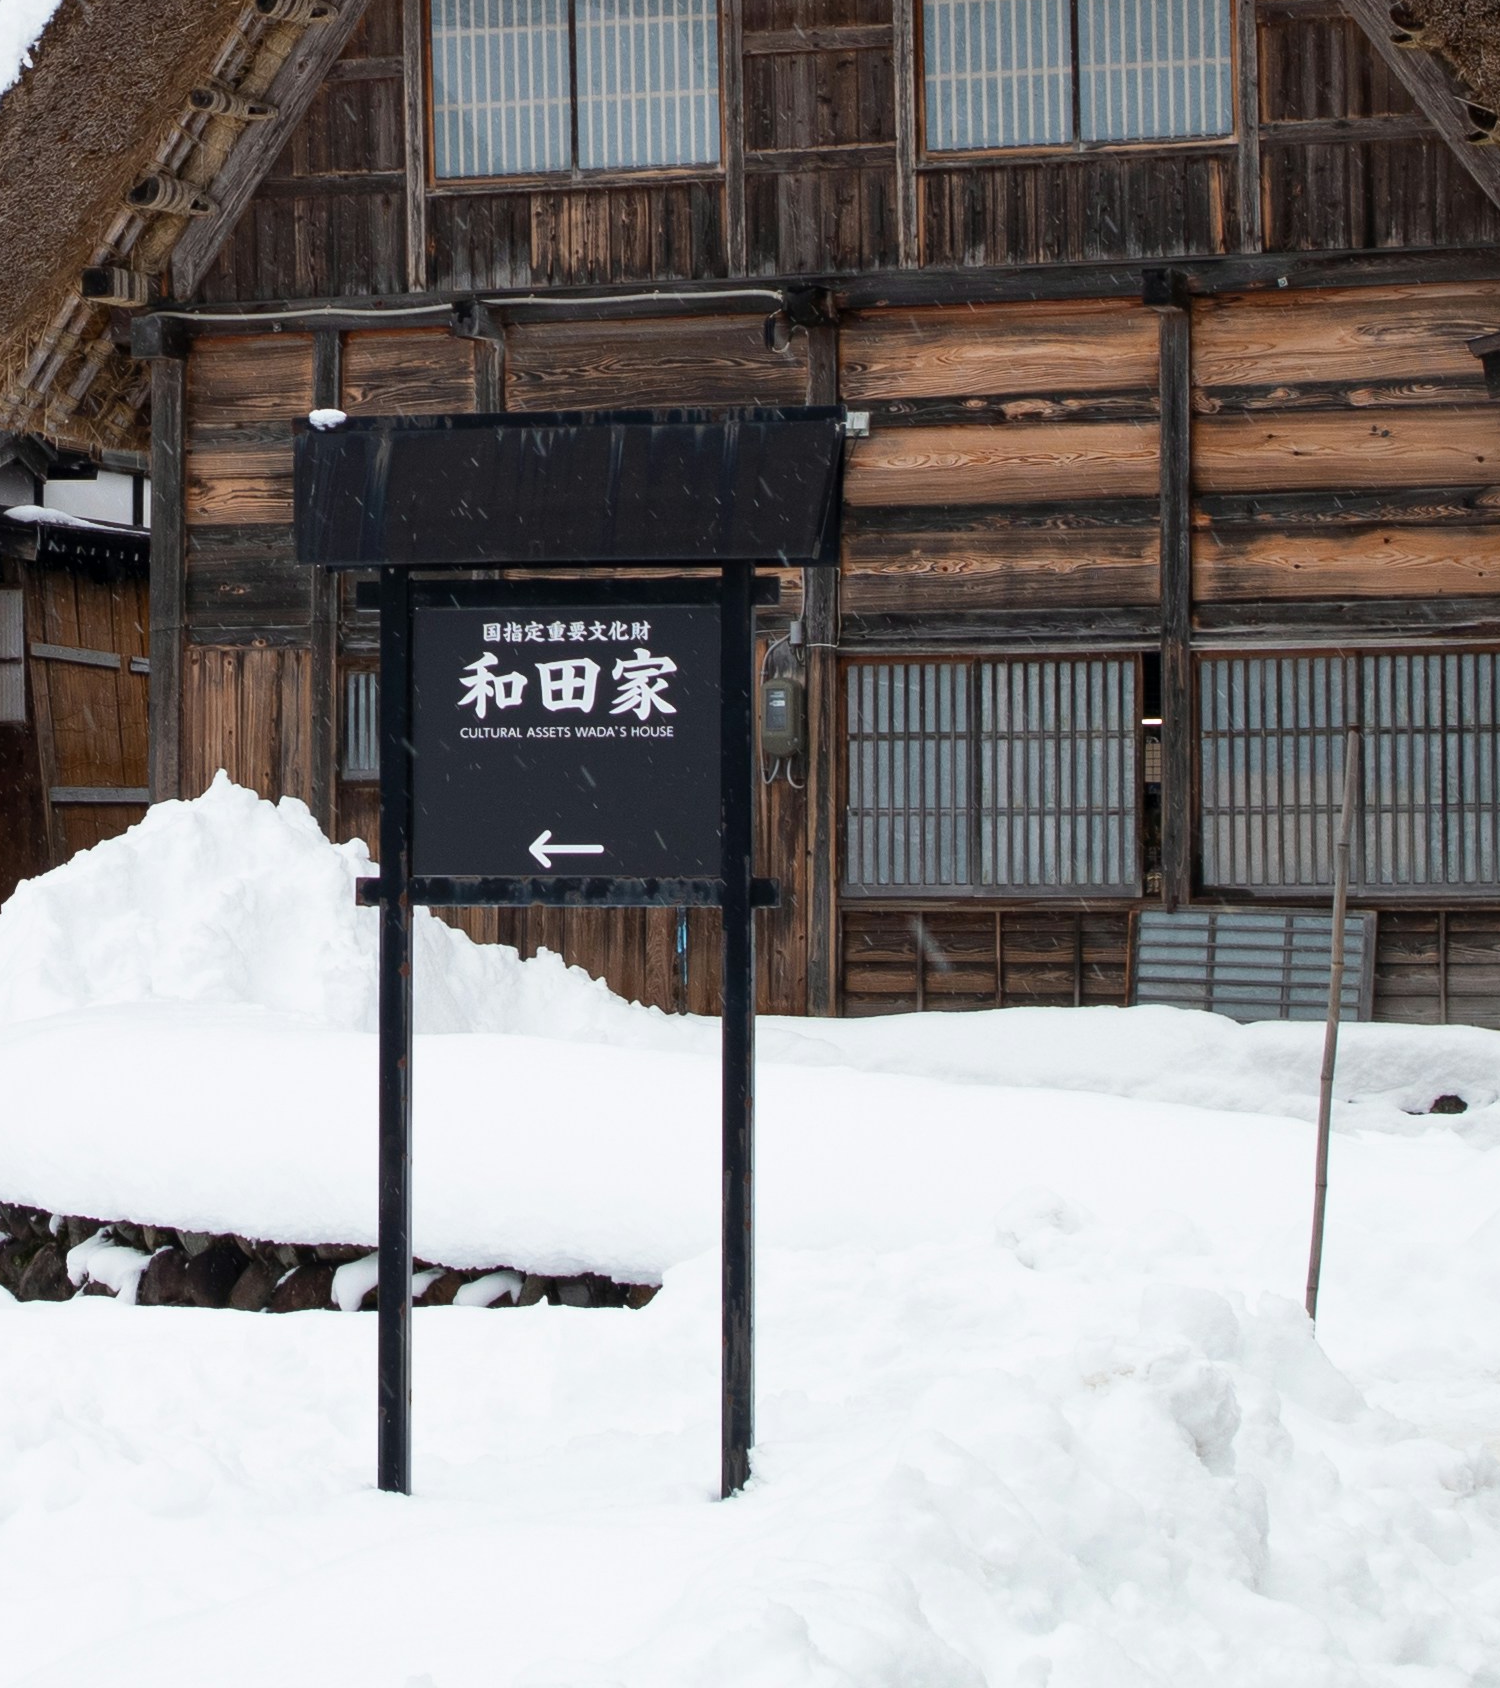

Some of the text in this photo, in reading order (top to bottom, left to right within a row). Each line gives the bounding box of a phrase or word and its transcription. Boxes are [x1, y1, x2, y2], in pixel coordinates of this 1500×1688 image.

[482, 620, 652, 643] 国指定重要文化財
[457, 647, 678, 721] 和田家
[459, 727, 523, 739] CULTURAL
[526, 726, 572, 738] ASSETS
[630, 725, 674, 738] HOUSE
